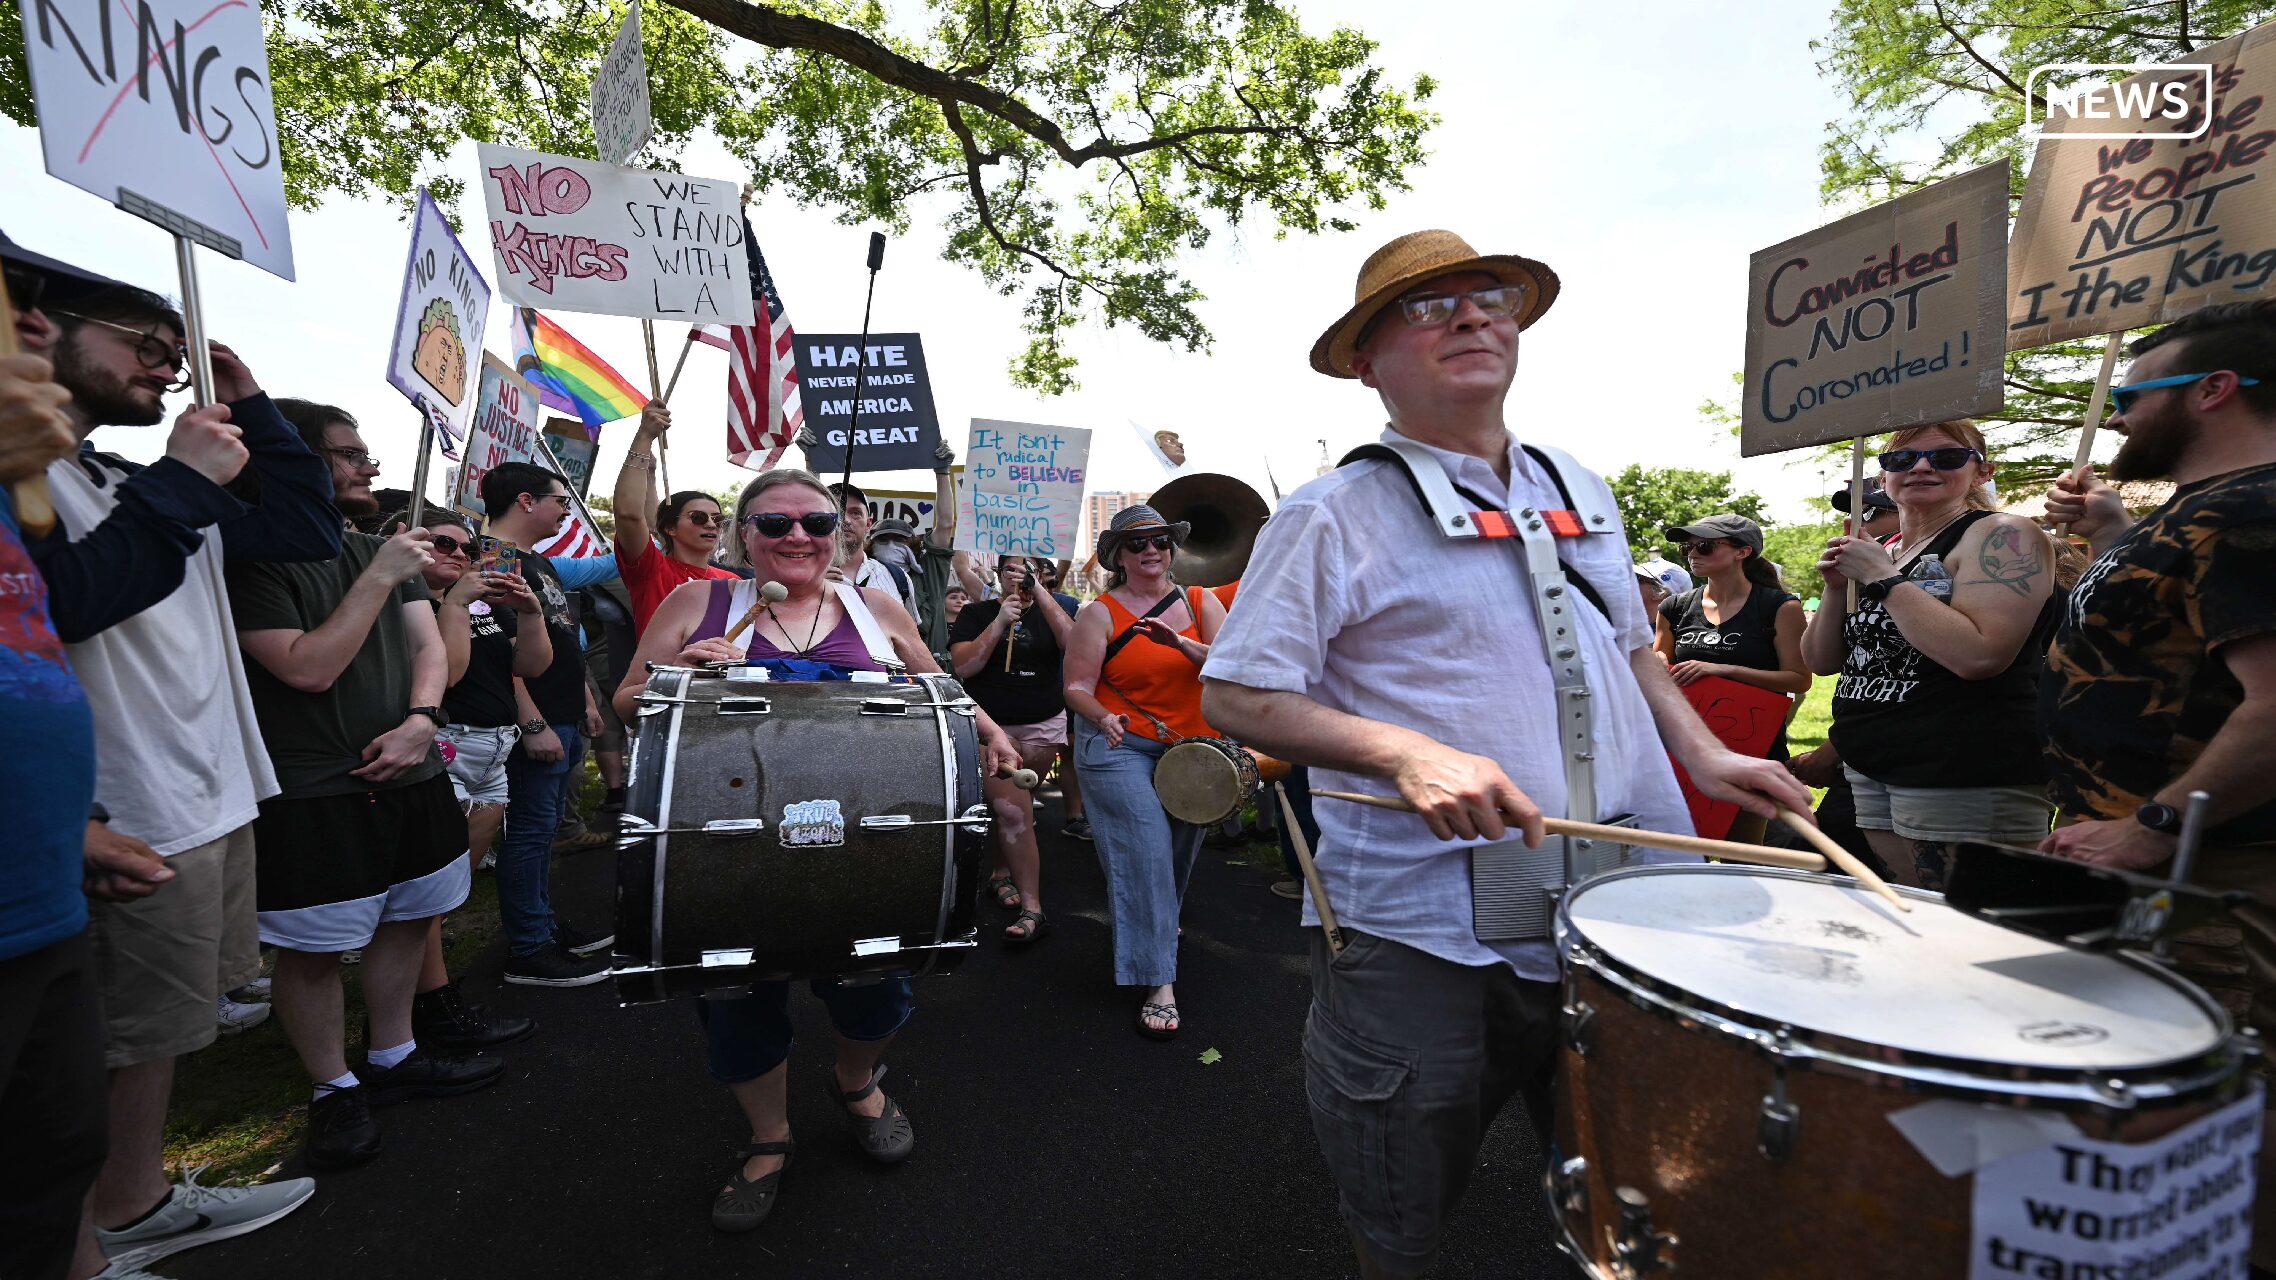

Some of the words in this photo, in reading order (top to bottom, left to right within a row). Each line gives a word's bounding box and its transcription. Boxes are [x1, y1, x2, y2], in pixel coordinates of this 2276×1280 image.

[488, 162, 591, 217] NO
[653, 178, 711, 205] WE
[626, 202, 743, 247] STAND
[2076, 173, 2255, 259] NOT
[490, 220, 628, 294] KINGS
[653, 245, 731, 280] WITH
[1765, 221, 1959, 327] Convicted
[413, 249, 436, 294] NO
[449, 251, 480, 343] KINGS
[2011, 281, 2055, 331] I
[2060, 266, 2151, 319] the
[1807, 272, 1953, 361] NOT
[809, 345, 908, 367] HATE
[807, 376, 857, 389] NEVER
[867, 373, 915, 386] MADE
[498, 379, 519, 416] NO
[820, 397, 913, 416] AMERICA
[479, 403, 533, 455] JUSTICE
[826, 427, 919, 446] GREAT
[971, 429, 1004, 450] It
[1018, 432, 1065, 450] isn't
[974, 463, 996, 479] to
[1008, 465, 1084, 484] BELIEVE
[1018, 481, 1039, 495] in
[974, 483, 1050, 511] basic
[975, 508, 1050, 536] human
[975, 530, 1055, 555] rights
